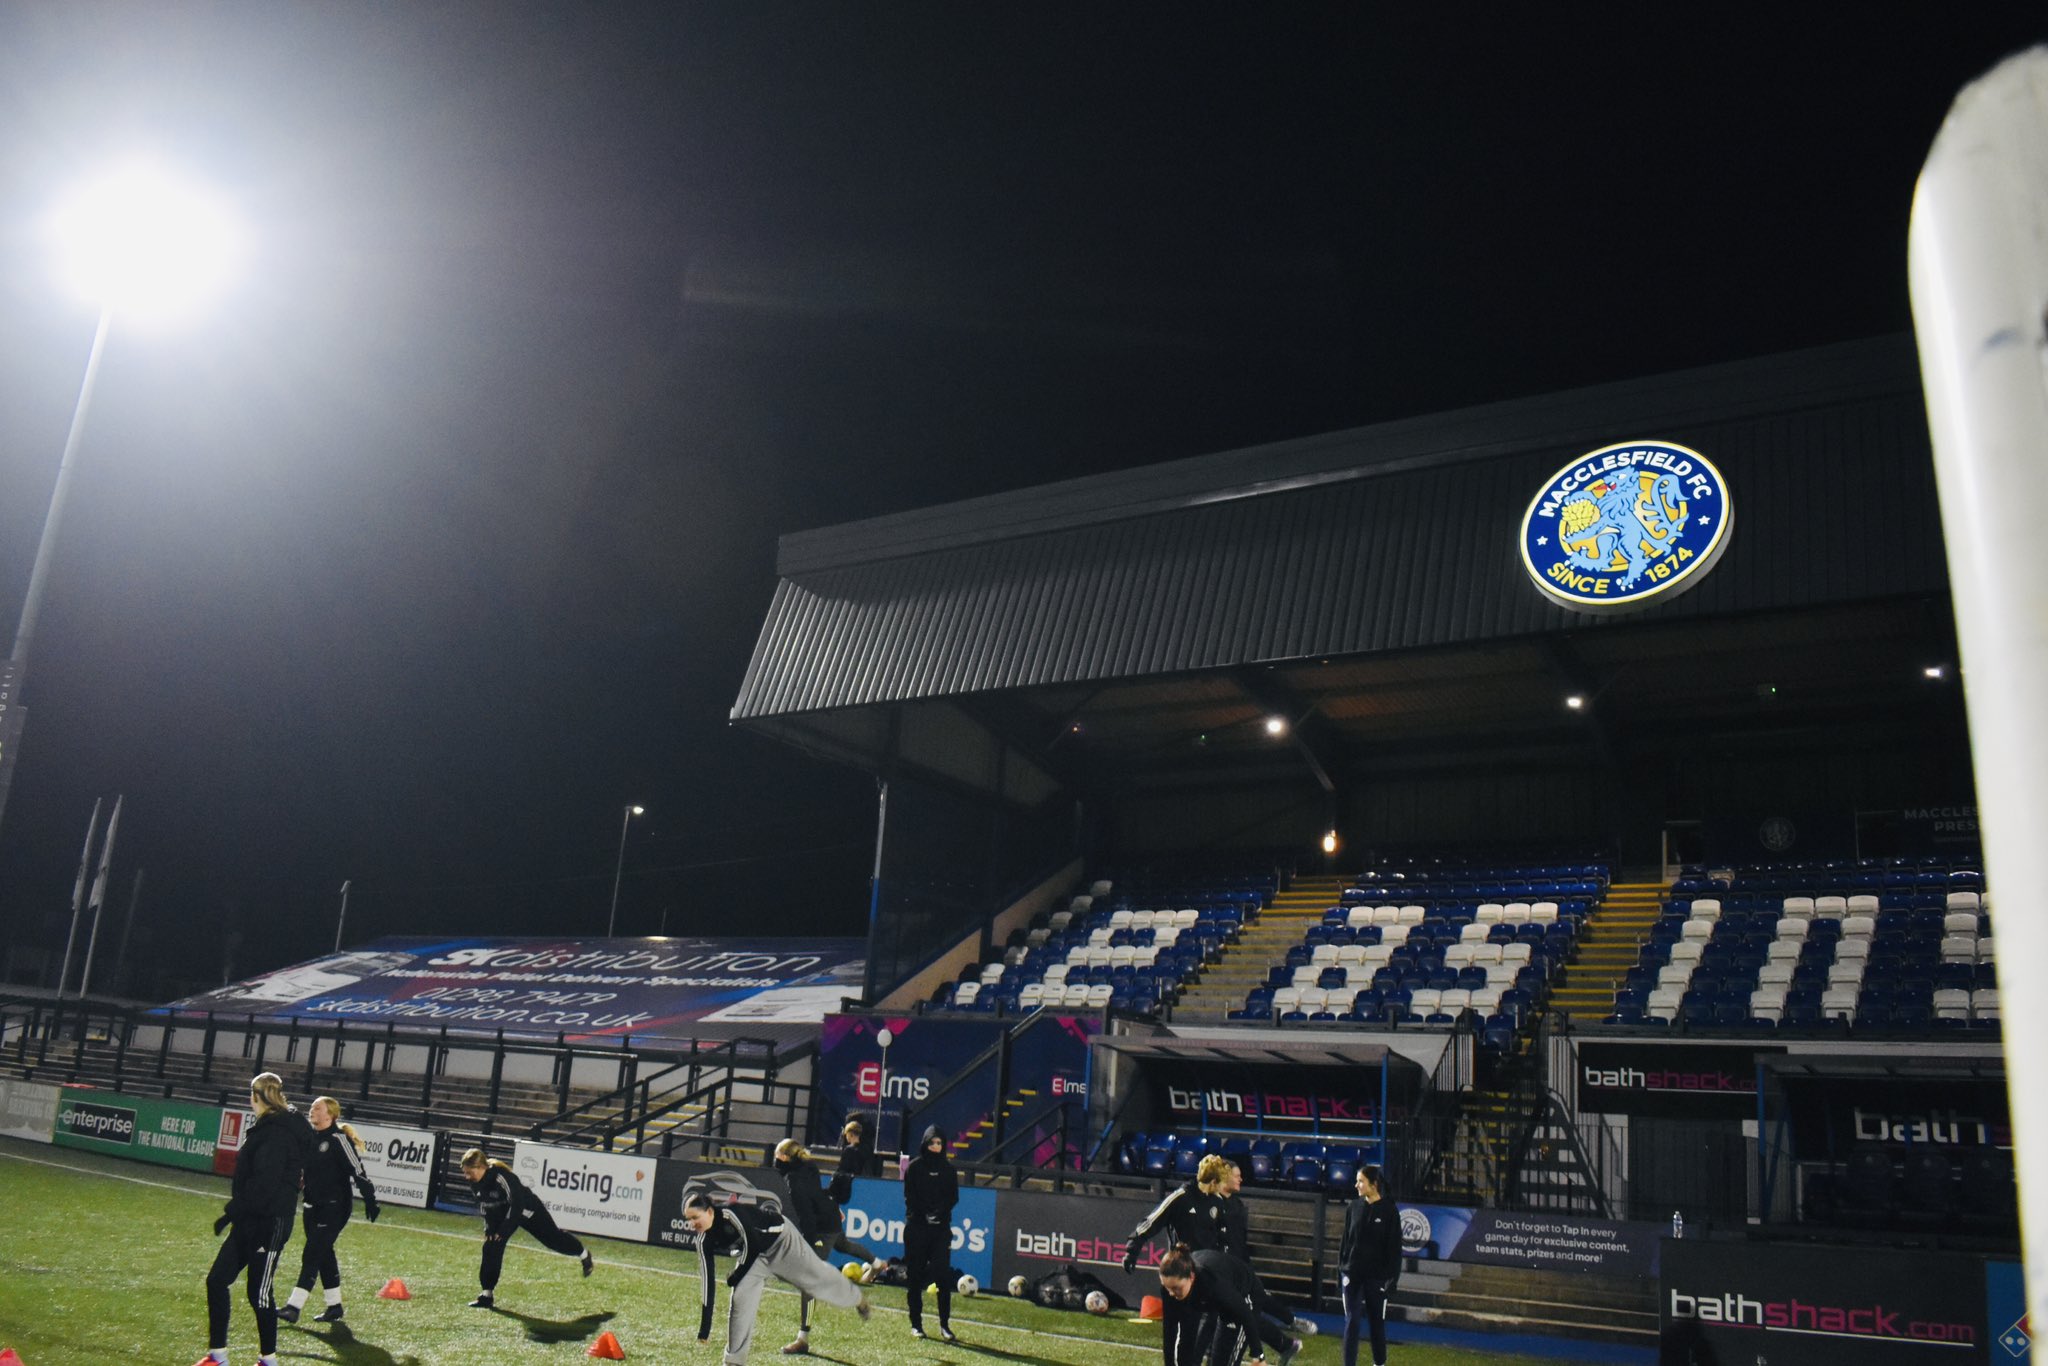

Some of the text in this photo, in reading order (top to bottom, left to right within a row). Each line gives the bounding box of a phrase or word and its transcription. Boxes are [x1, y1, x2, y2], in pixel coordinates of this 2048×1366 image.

[1538, 451, 1712, 518] MACCLESFIELD FC
[1546, 546, 1694, 594] SINCE 1874
[643, 975, 780, 988] Specialists
[859, 1067, 930, 1100] Elms
[1584, 1066, 1759, 1092] bathshack.co
[61, 1108, 133, 1134] enterprise
[160, 1116, 196, 1135] HERE FOR
[138, 1130, 216, 1157] THE NATIONAL LEAGUE
[387, 1138, 430, 1164] Orbit
[386, 1160, 425, 1172] Developments
[392, 1186, 424, 1200] BUSINESS
[540, 1159, 643, 1202] leasing.com
[552, 1204, 562, 1213] car
[563, 1203, 587, 1217] leasing
[587, 1208, 627, 1222] comparison
[628, 1212, 641, 1224] site
[661, 1231, 673, 1242] WE
[674, 1233, 690, 1244] BUY
[846, 1208, 985, 1252] Domo's
[1495, 1219, 1617, 1240] Don't forget to Tap In every
[1475, 1243, 1499, 1255] team
[1526, 1248, 1555, 1260] prizes
[1556, 1249, 1574, 1261] and
[1575, 1252, 1603, 1264] more!
[1485, 1232, 1630, 1254] game day for exclusive content,
[1670, 1288, 1975, 1342] bathshack.com
